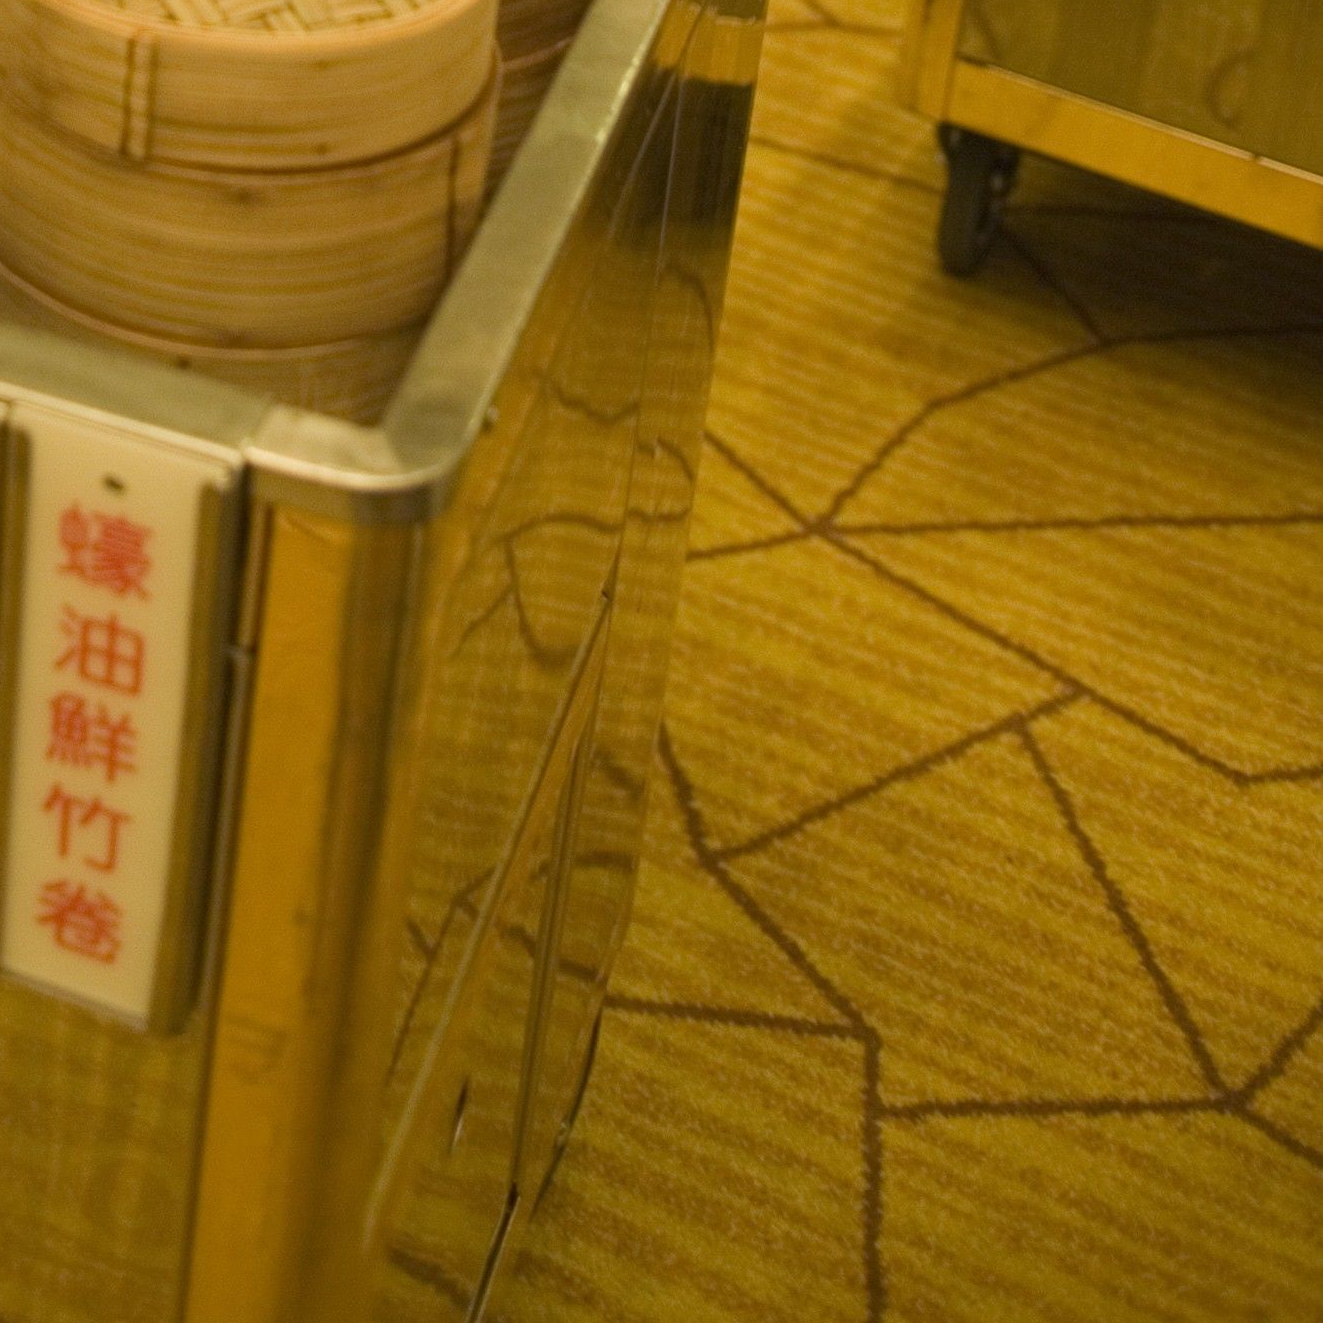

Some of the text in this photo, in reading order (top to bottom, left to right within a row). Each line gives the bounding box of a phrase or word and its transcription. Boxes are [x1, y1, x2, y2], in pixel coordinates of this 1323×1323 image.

[36, 501, 155, 964] 蠔油鮮竹卷
